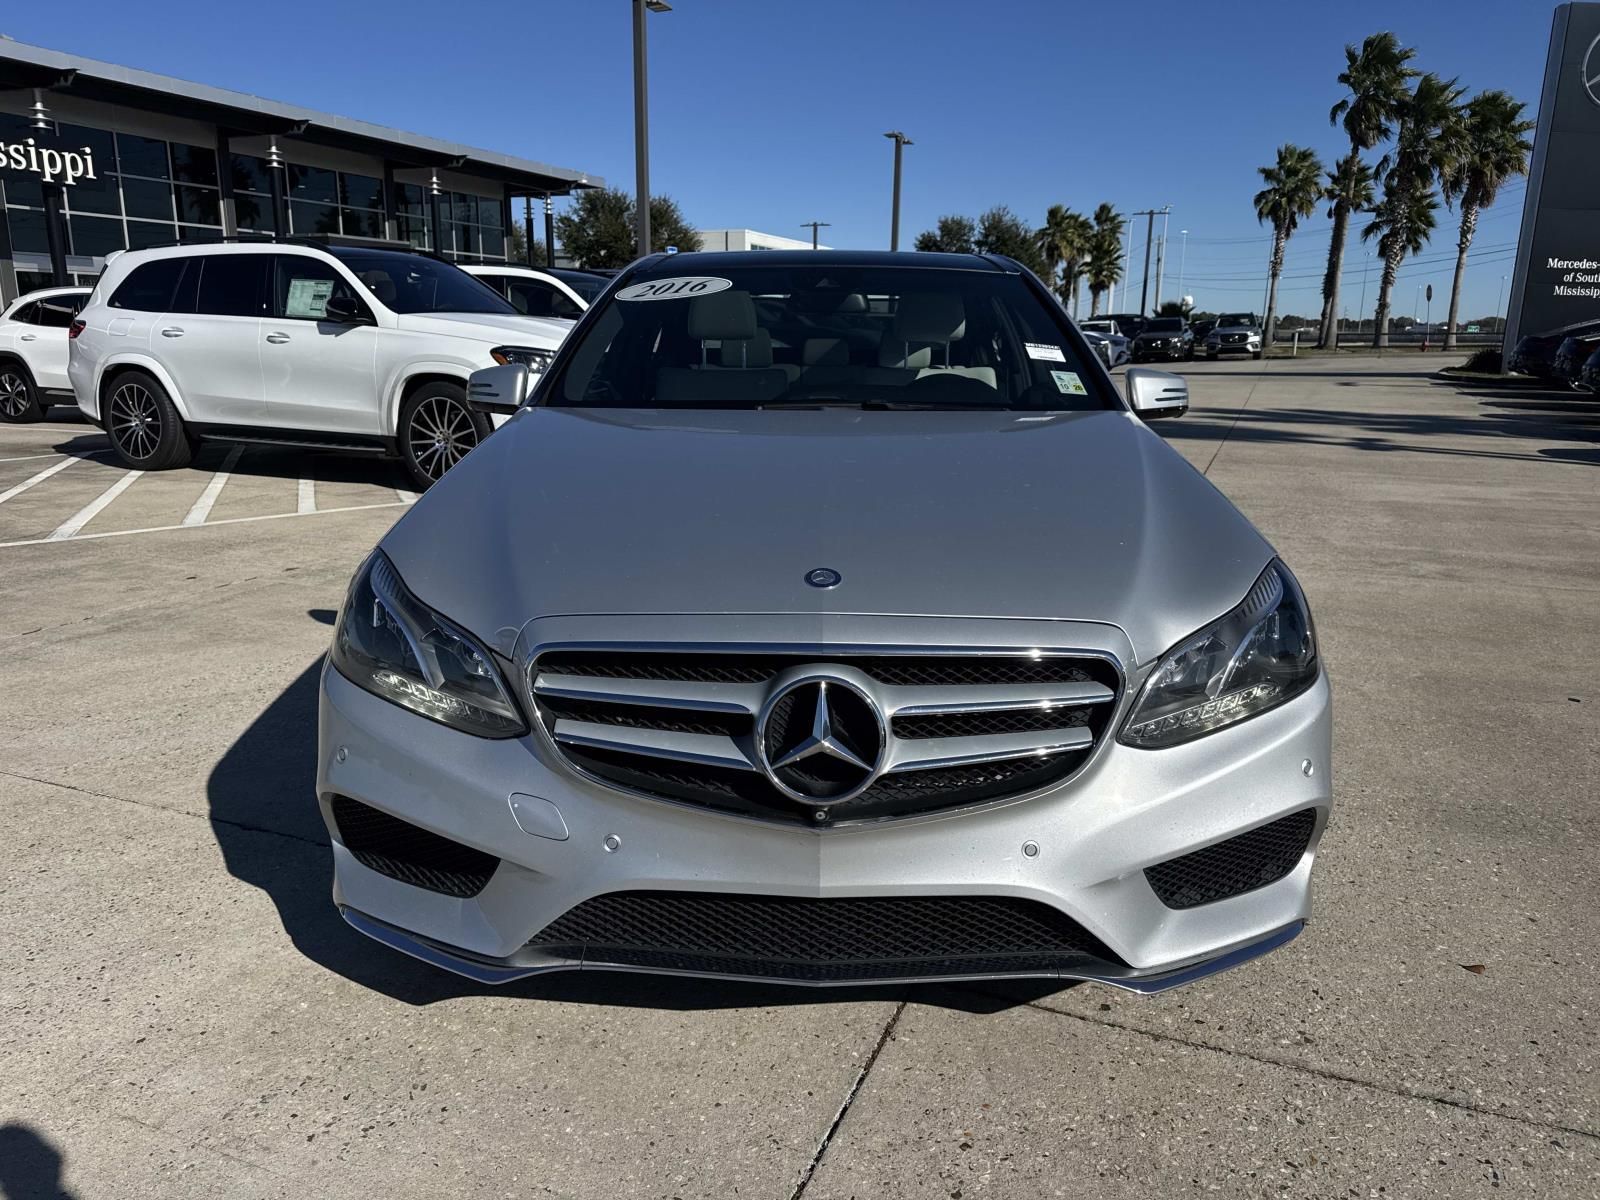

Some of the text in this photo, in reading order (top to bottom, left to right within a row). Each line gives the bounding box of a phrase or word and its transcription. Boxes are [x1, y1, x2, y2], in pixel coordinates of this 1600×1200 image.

[1546, 257, 1600, 269] Mercedes-
[1563, 272, 1600, 283] of Sout
[631, 279, 714, 298] 2016
[1553, 285, 1600, 299] Mississip
